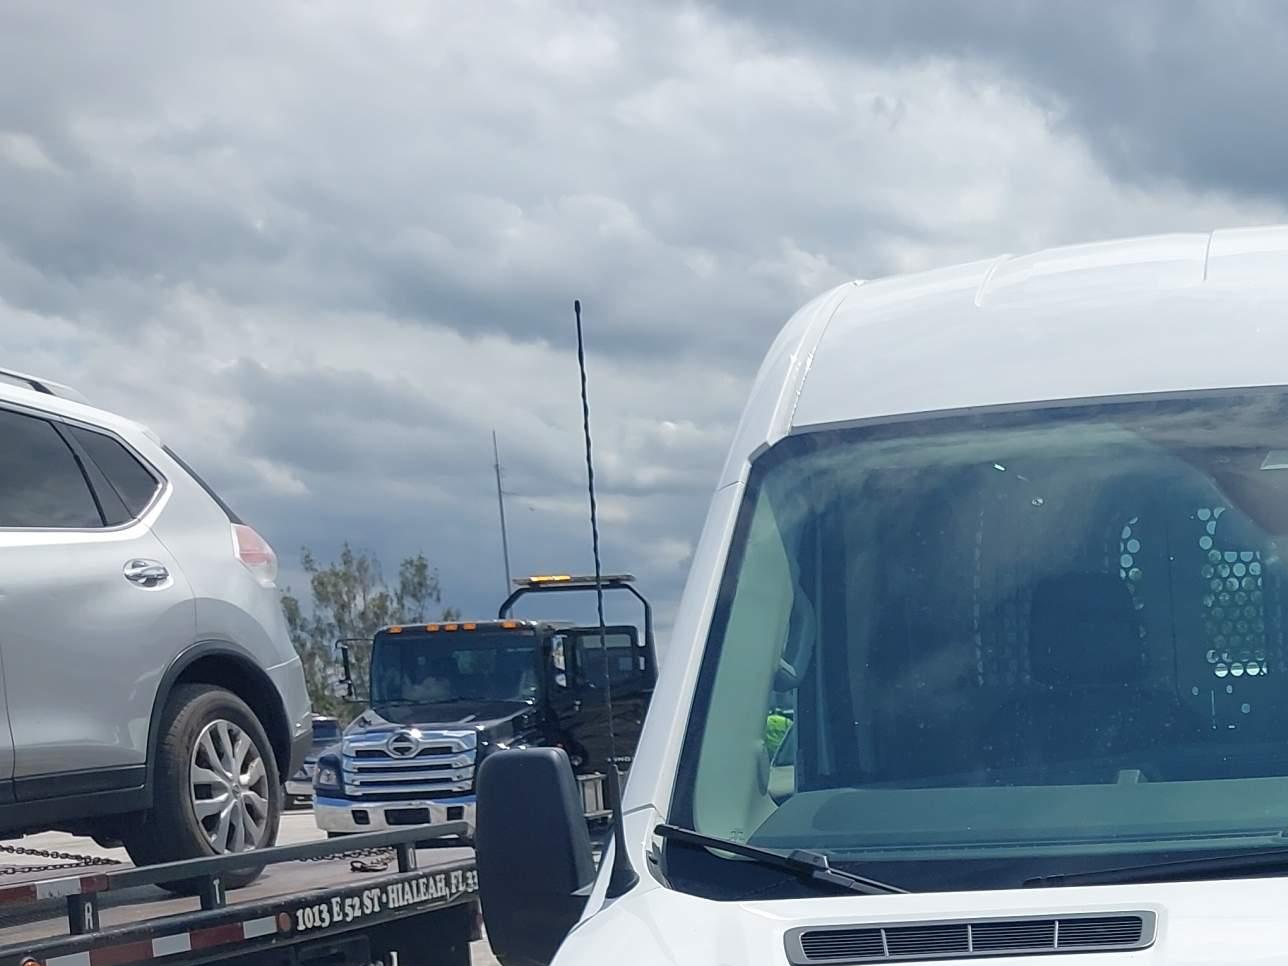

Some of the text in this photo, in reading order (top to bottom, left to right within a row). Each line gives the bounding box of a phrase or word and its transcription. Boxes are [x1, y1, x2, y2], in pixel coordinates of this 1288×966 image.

[84, 901, 94, 930] R
[296, 904, 331, 931] 1013
[331, 896, 343, 923] E
[344, 897, 363, 922] 52
[363, 889, 382, 914] ST
[388, 873, 451, 908] HIALEAH,
[450, 870, 466, 893] FL
